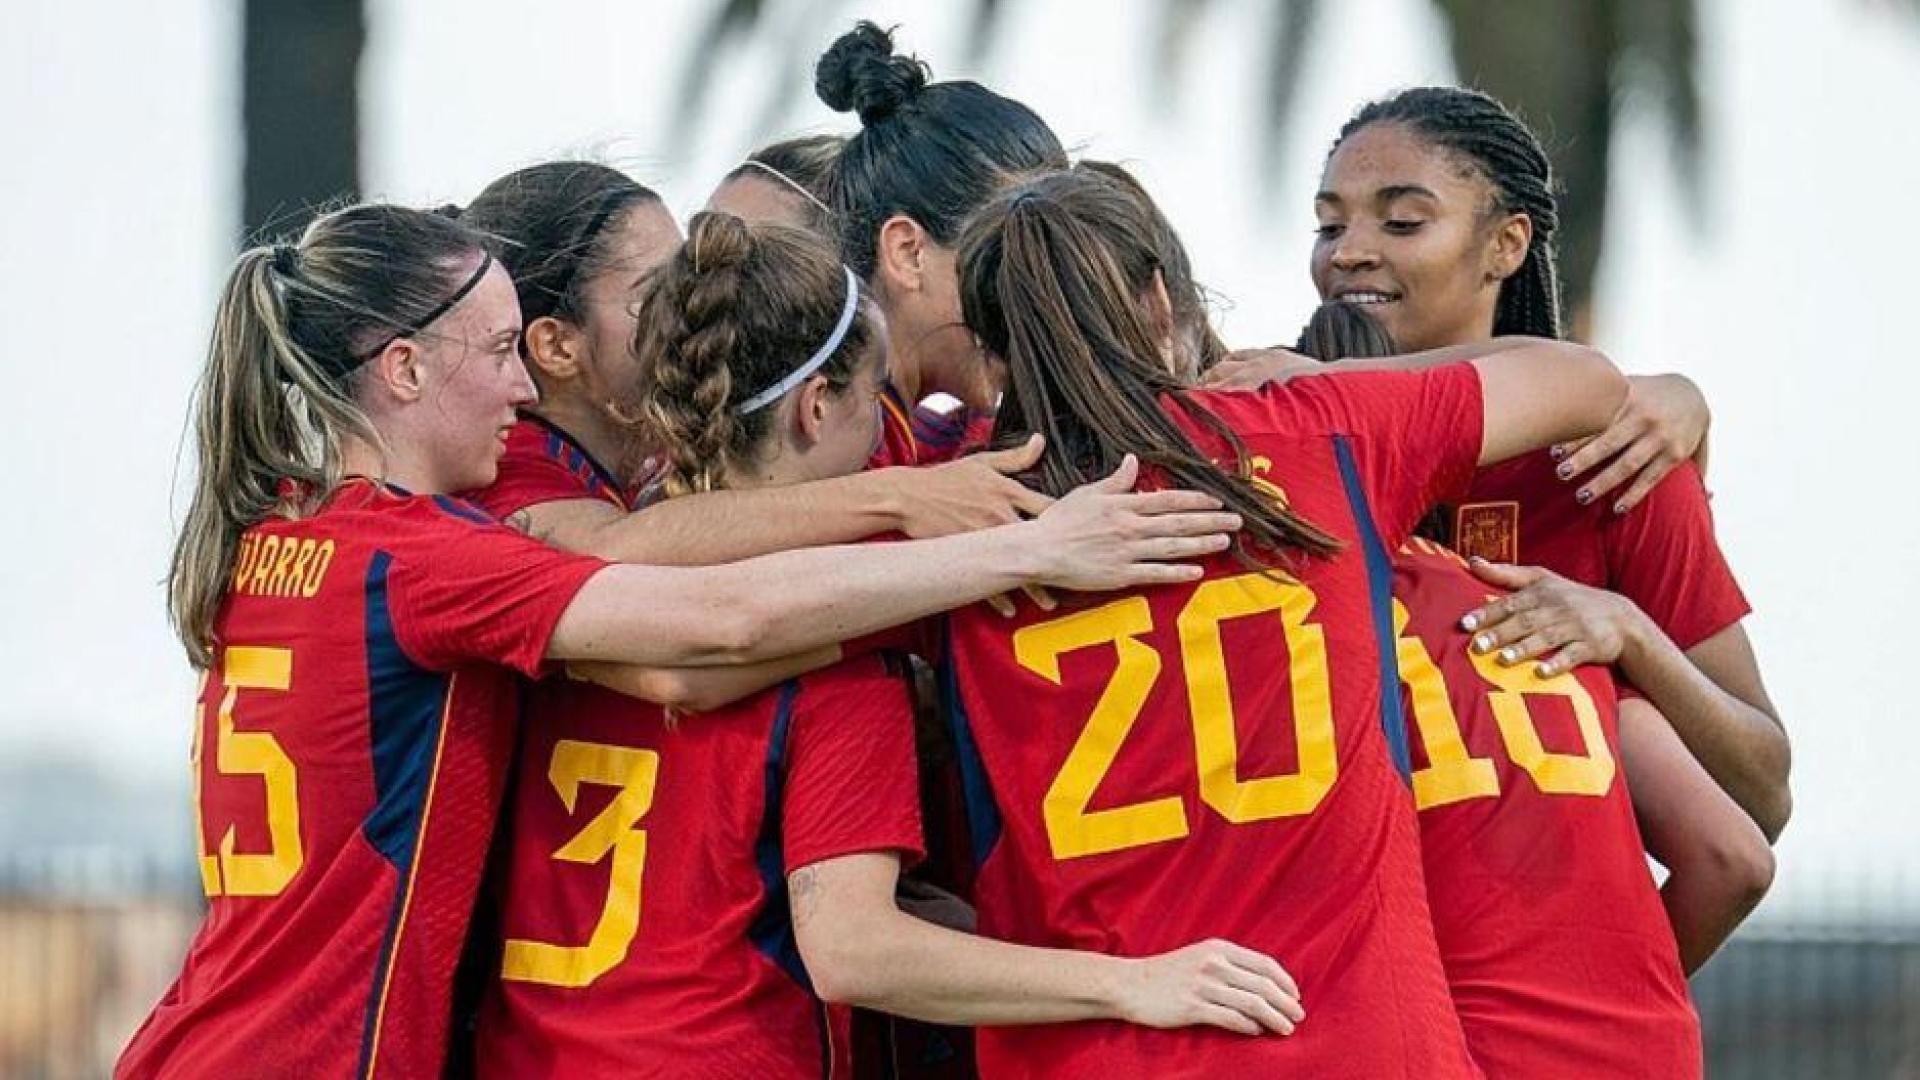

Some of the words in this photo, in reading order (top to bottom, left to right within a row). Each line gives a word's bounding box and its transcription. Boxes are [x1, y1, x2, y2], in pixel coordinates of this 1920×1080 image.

[1013, 568, 1338, 860] 20
[1392, 595, 1616, 811] 18
[501, 740, 660, 988] 3
